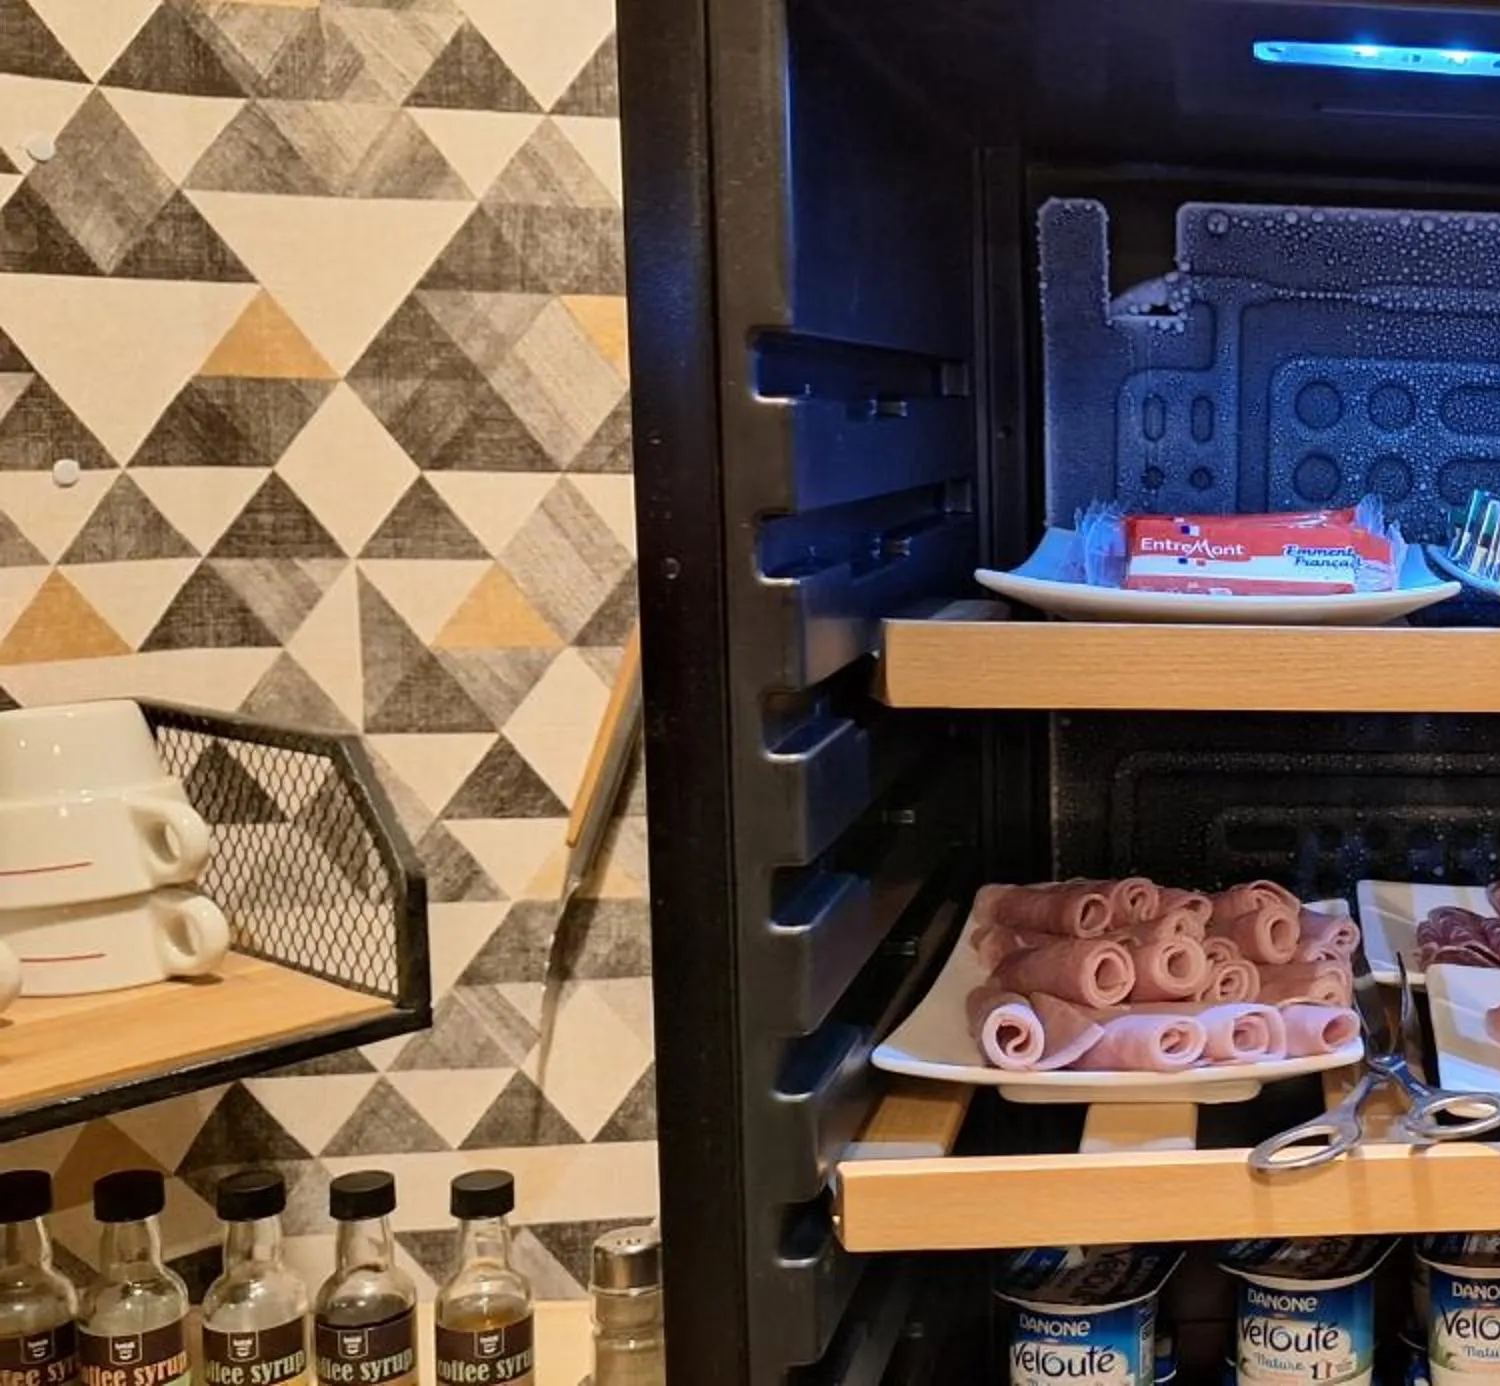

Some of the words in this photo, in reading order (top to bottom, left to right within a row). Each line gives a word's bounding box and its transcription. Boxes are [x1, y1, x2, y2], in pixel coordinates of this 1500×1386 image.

[1247, 1288, 1320, 1313] DANONE
[1019, 1314, 1091, 1337] DANONE
[1239, 1316, 1339, 1353] Velouté
[133, 1351, 188, 1386] syrup
[251, 1350, 305, 1384] syrup
[360, 1348, 413, 1382] syrup
[437, 1359, 490, 1382] coffee
[1012, 1343, 1115, 1377] Velouté
[1254, 1351, 1304, 1371] Nature
